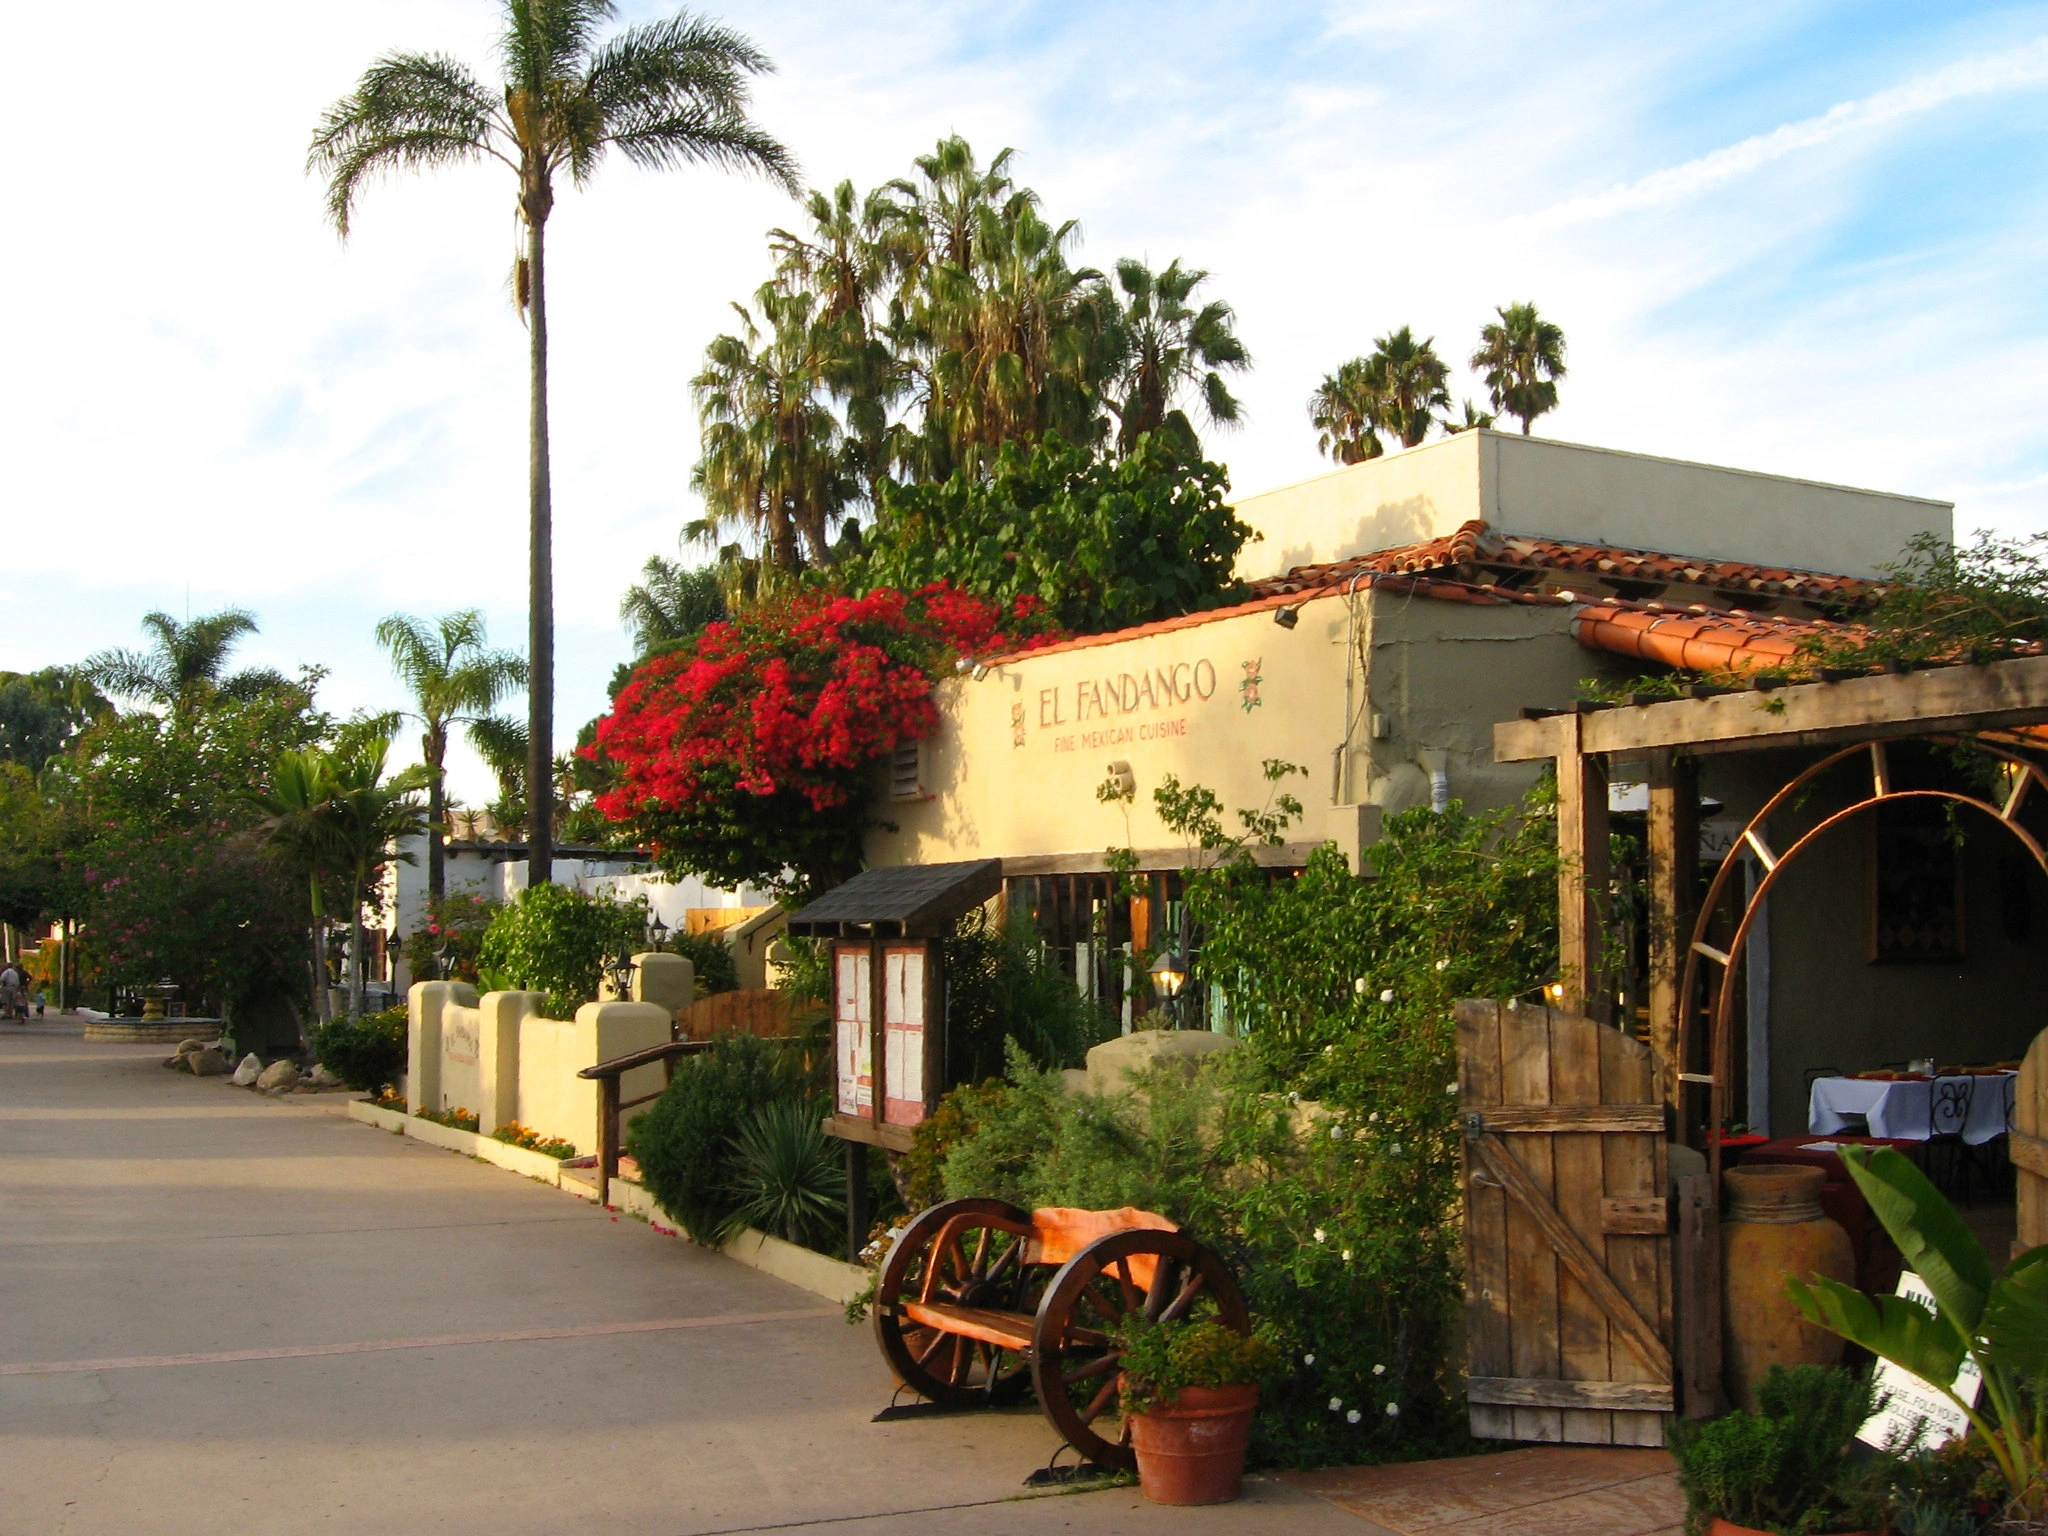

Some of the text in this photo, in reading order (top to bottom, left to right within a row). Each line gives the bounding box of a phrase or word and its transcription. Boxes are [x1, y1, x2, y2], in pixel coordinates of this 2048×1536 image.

[1040, 659, 1216, 728] EL FANDANGO
[1054, 718, 1186, 753] FINE MEXICAN CUISINE
